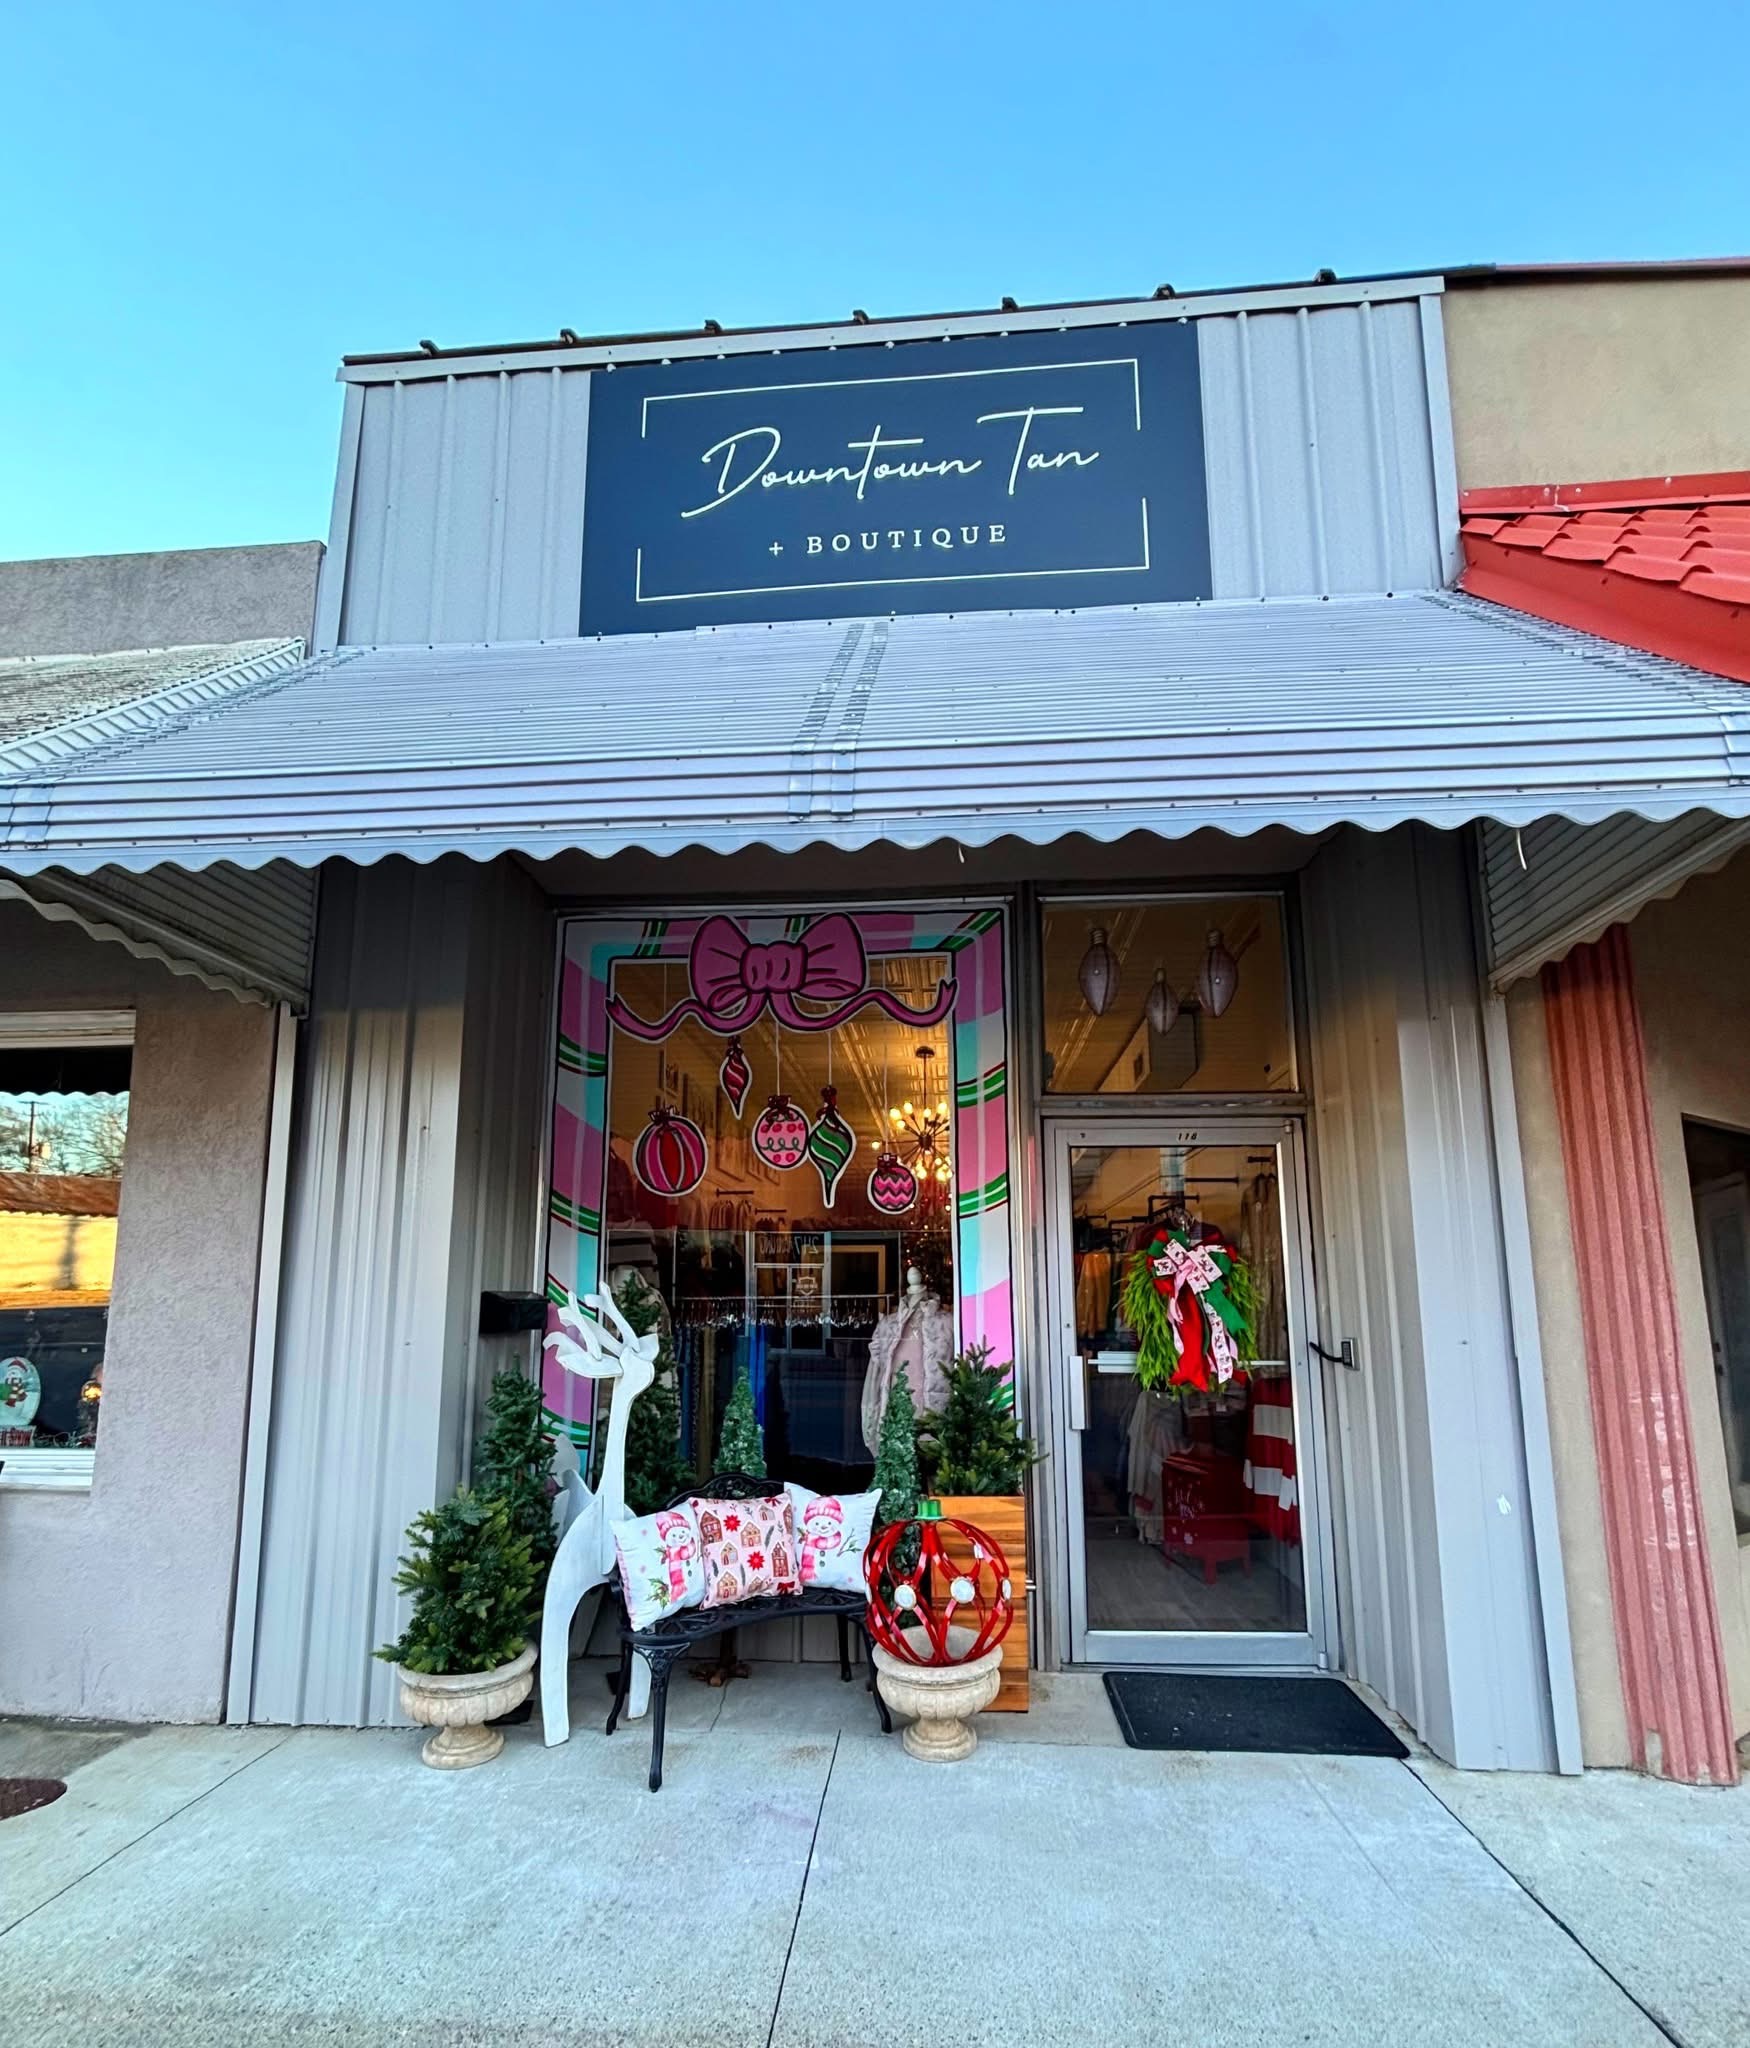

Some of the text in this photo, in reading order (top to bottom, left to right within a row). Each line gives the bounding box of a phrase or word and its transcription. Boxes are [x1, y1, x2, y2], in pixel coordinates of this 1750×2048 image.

[680, 406, 1100, 518] Downtown Tan
[806, 524, 1006, 554] BOUTIQUE
